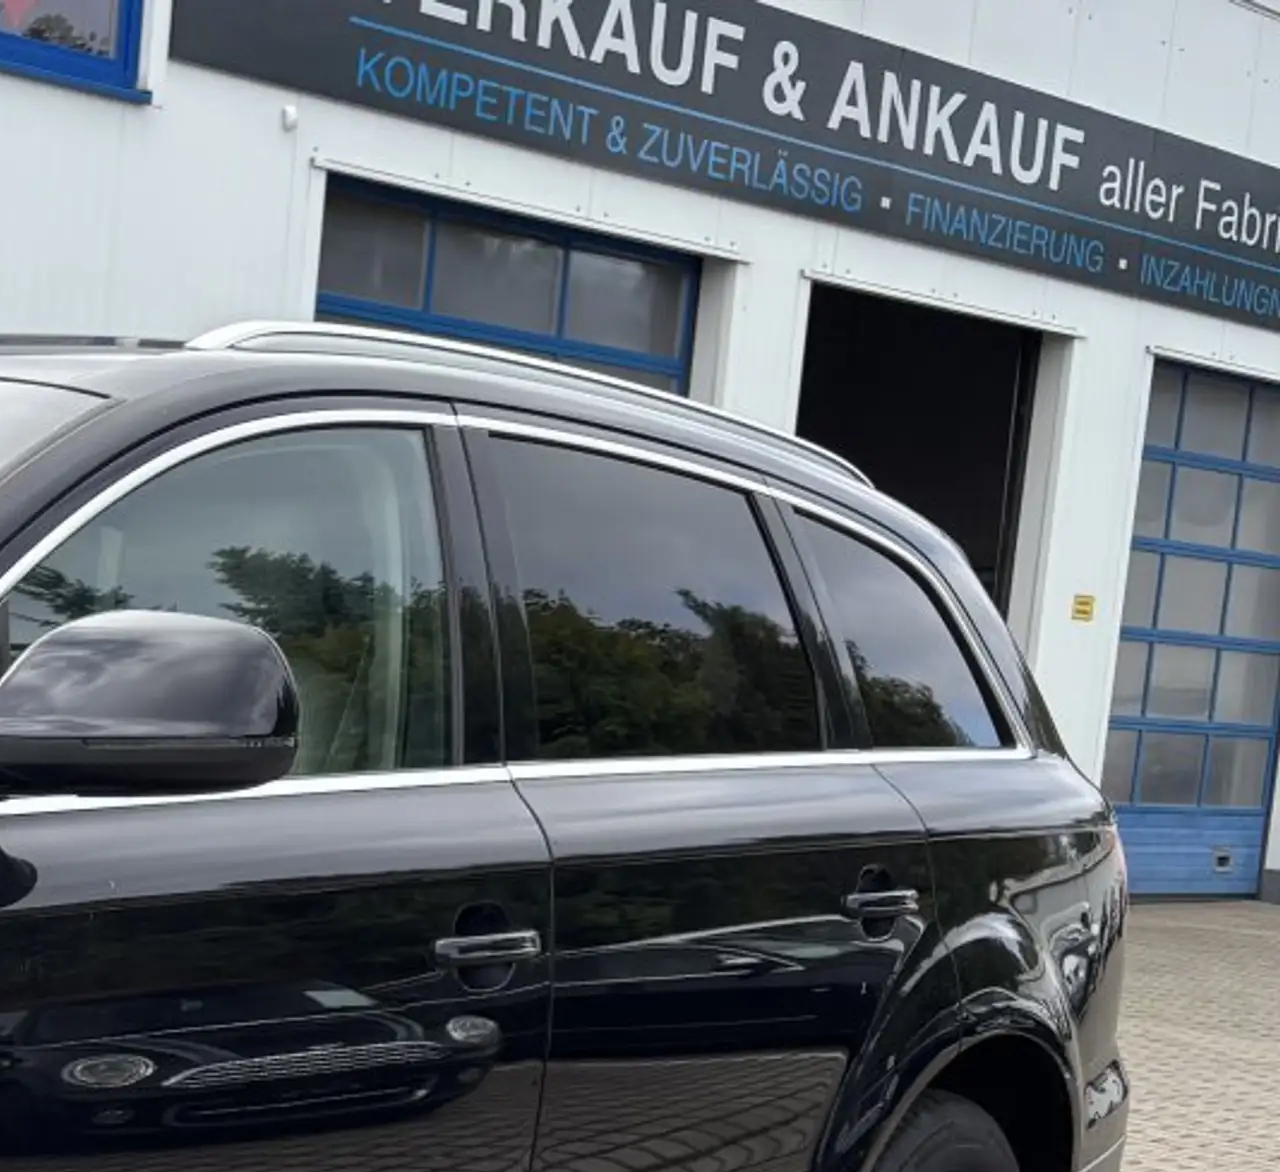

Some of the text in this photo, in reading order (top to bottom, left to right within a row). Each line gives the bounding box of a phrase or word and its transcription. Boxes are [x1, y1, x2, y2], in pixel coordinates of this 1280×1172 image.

[356, 47, 600, 145] KOMPETENT
[605, 114, 628, 155] &
[637, 122, 864, 213] ZUVERLÄSSIG
[905, 193, 1106, 273] FINANZIERUNG
[383, 0, 746, 95] KAUF
[762, 41, 806, 121] &
[826, 60, 1086, 192] ANKAUF
[1099, 158, 1185, 222] aller
